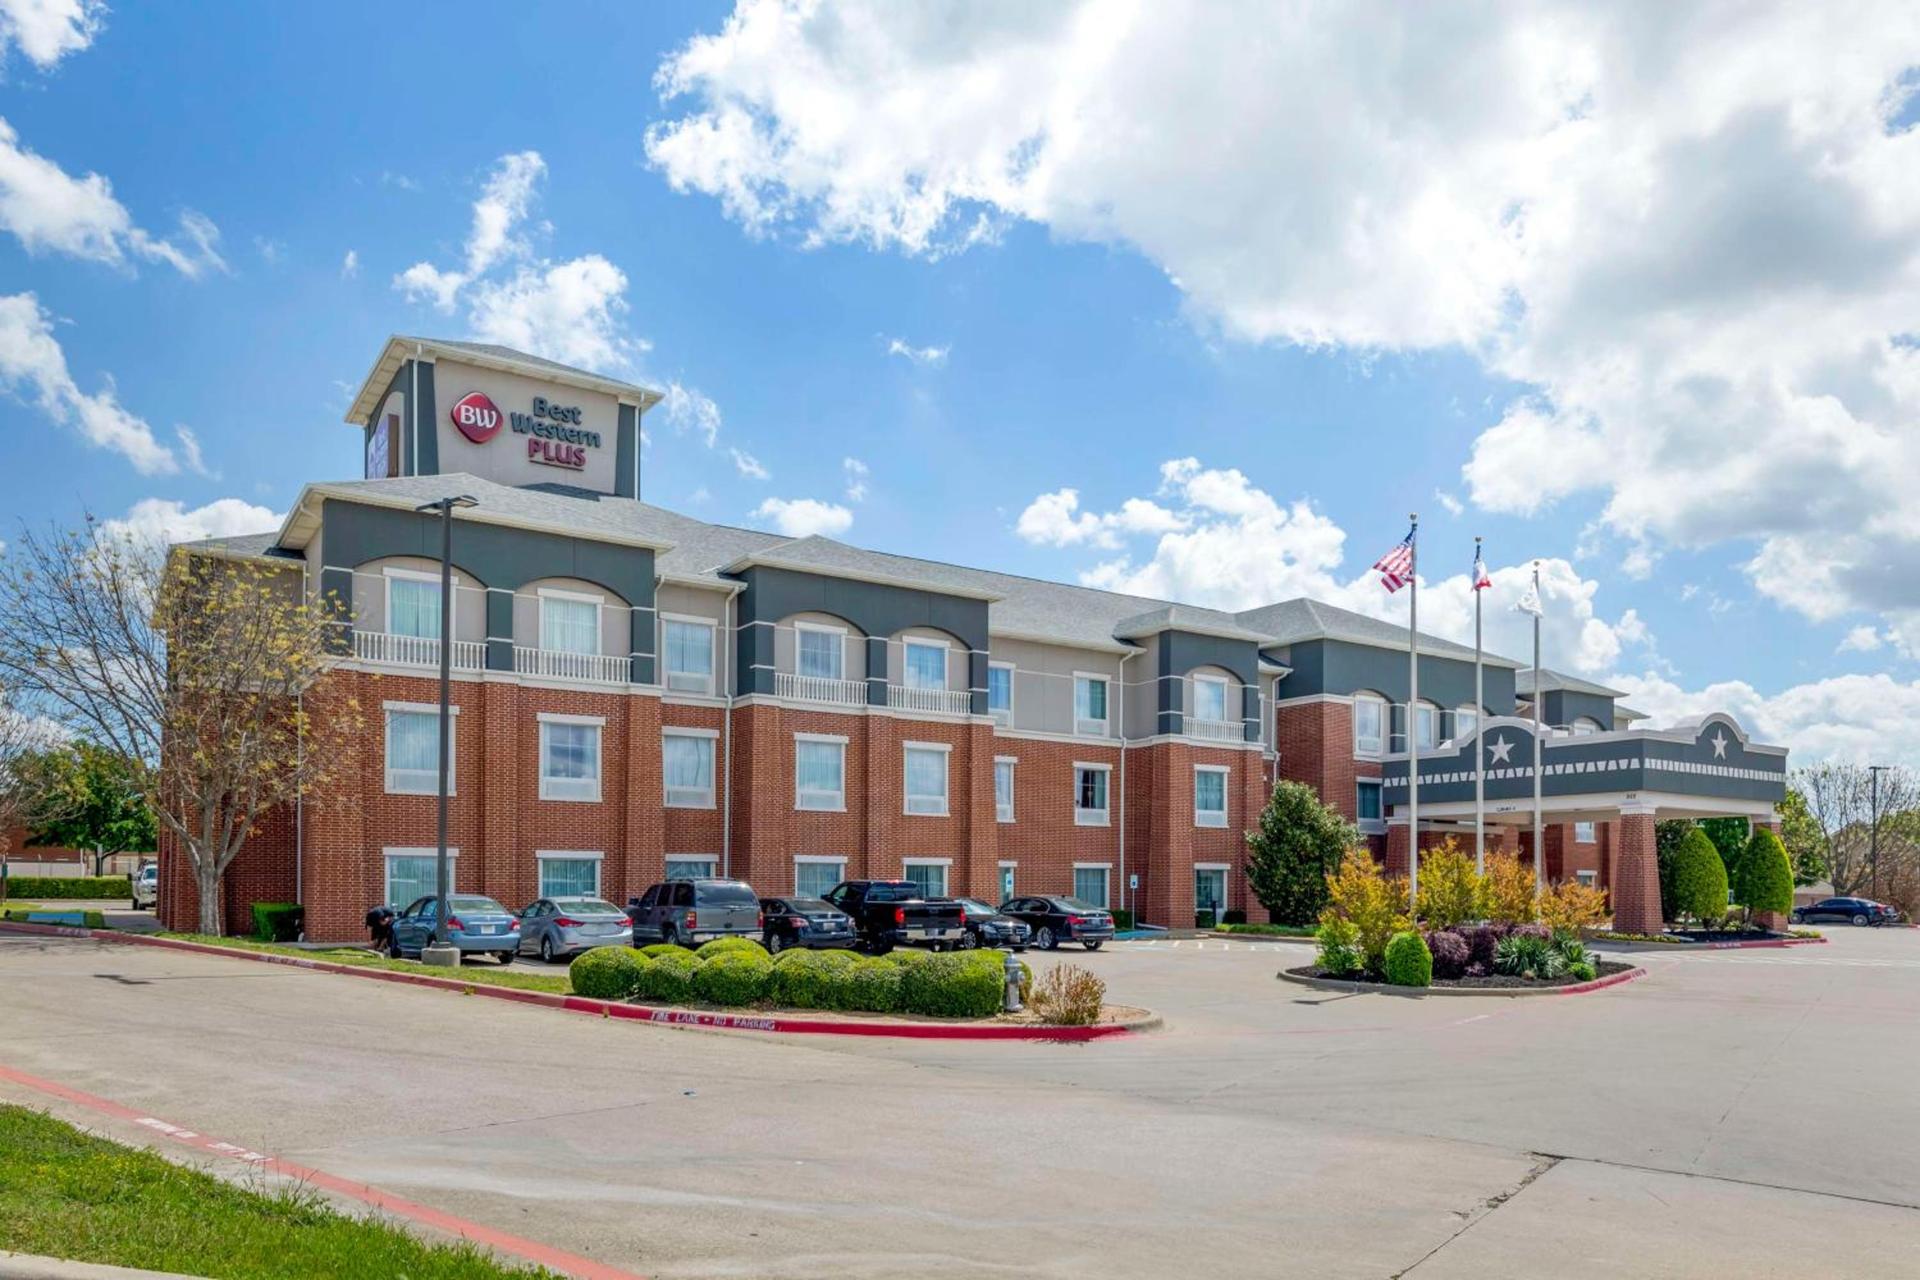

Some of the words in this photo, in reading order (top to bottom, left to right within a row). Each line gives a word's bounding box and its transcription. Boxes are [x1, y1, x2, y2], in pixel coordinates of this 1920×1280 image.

[460, 404, 497, 428] BW
[533, 396, 582, 424] Best
[510, 411, 602, 448] Western
[528, 437, 586, 467] PLUS
[676, 1012, 699, 1025] LANE
[713, 1016, 727, 1026] NO
[733, 1018, 776, 1031] PARKING
